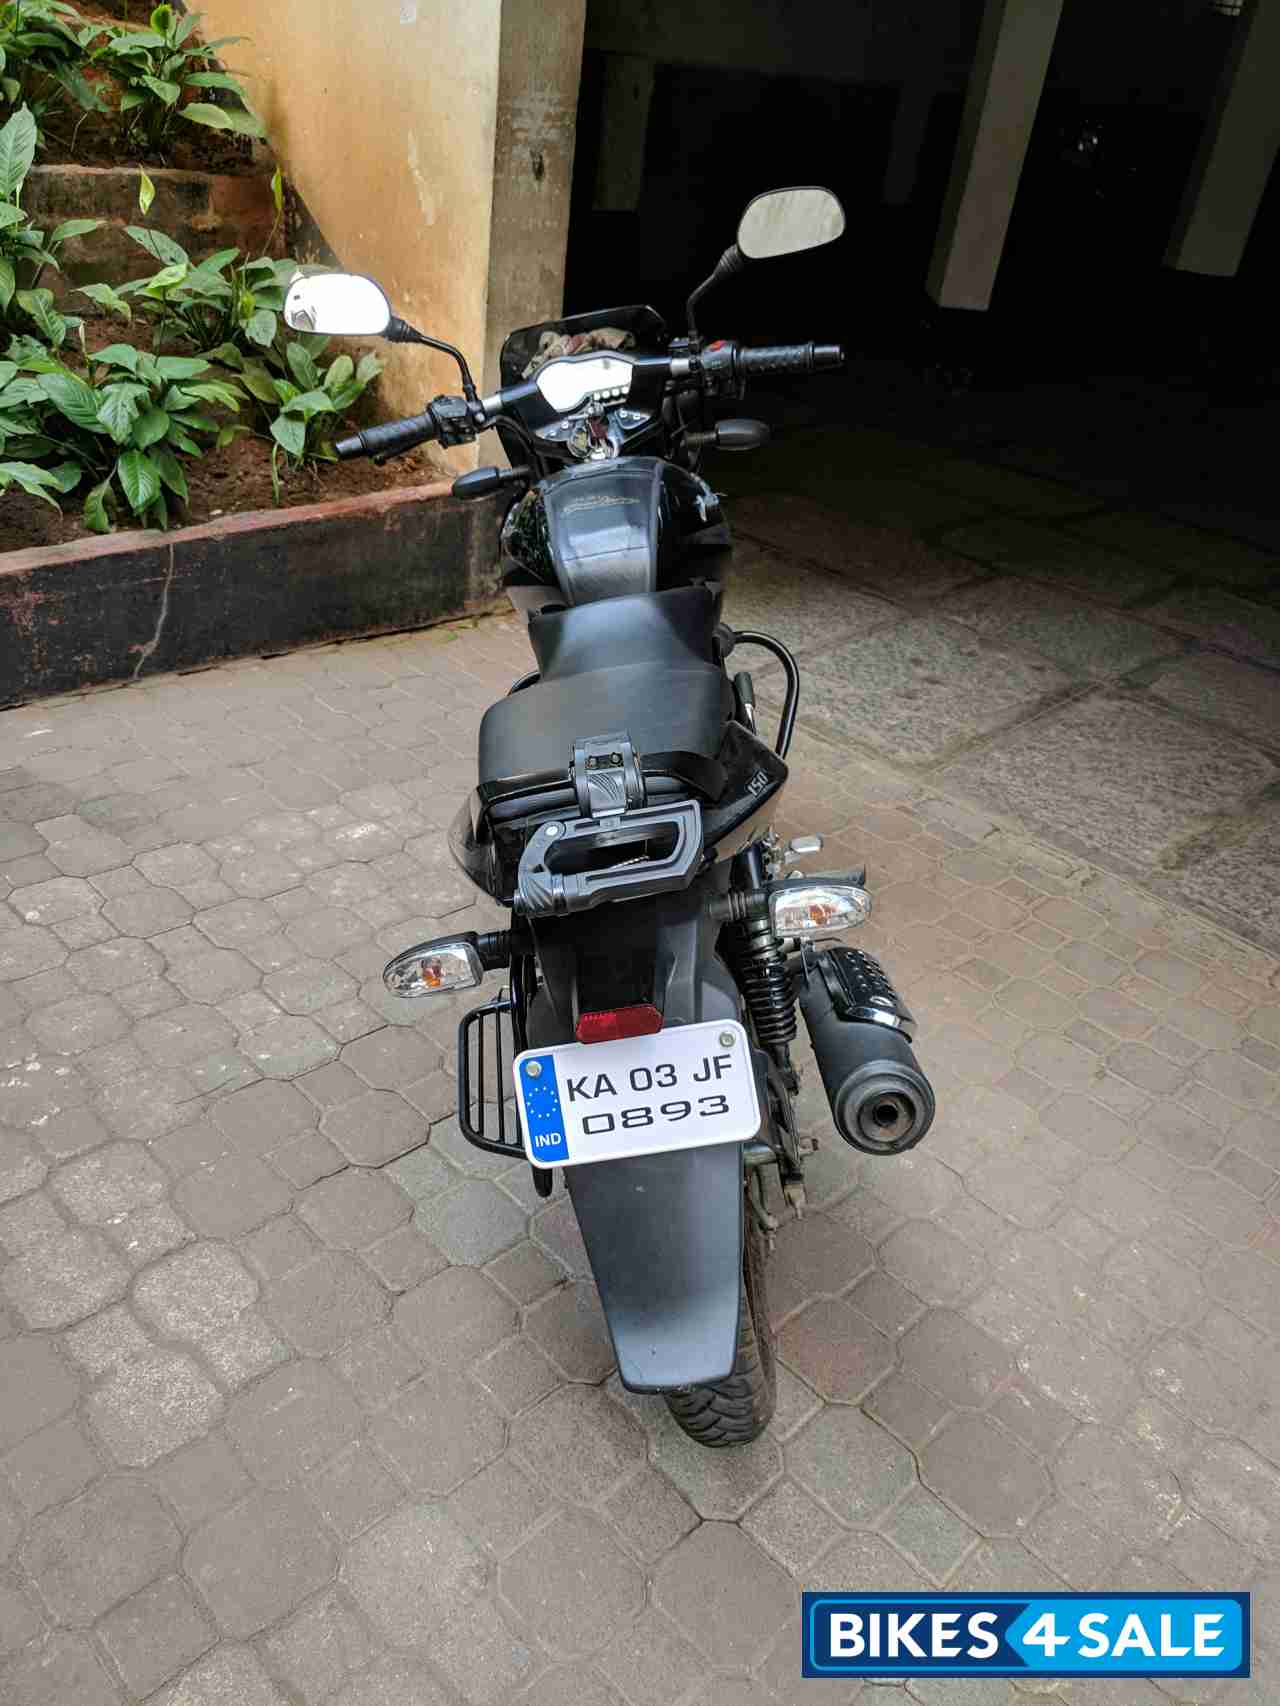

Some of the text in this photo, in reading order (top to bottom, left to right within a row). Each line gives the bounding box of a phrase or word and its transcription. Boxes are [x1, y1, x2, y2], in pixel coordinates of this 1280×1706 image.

[567, 1054, 732, 1102] KA 03 JF
[582, 1095, 730, 1135] 0893
[534, 1133, 562, 1148] IND
